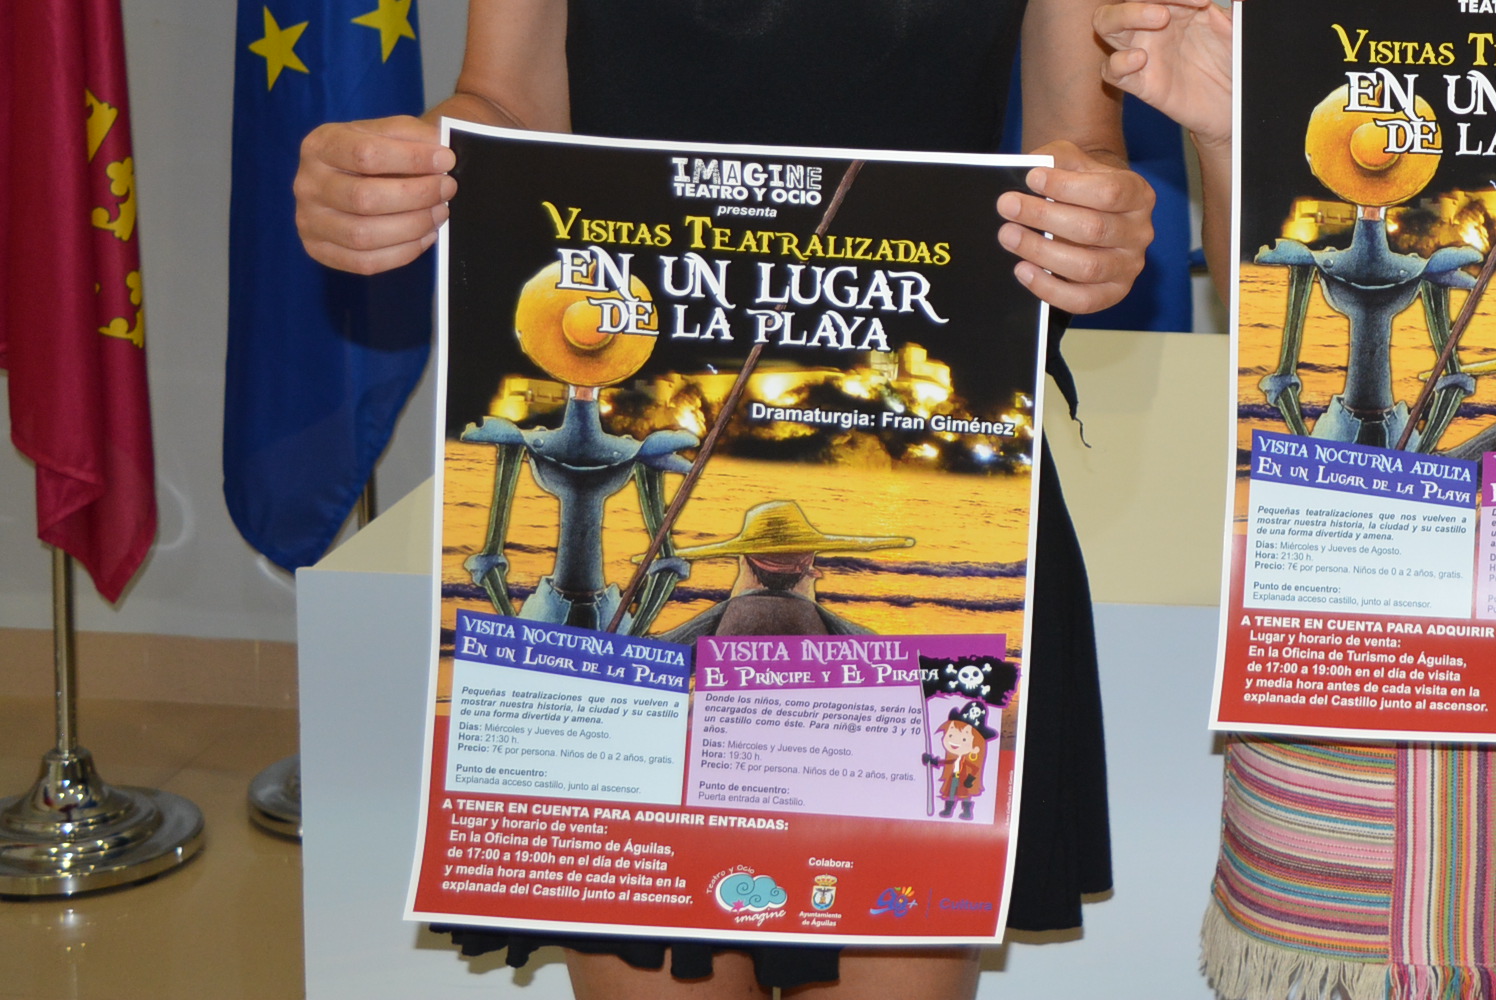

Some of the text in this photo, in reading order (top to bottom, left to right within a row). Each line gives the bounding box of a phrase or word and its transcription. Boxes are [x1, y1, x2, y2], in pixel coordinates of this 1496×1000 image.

[1331, 24, 1455, 66] VISITAS
[1344, 68, 1427, 121] EN
[1375, 118, 1443, 154] DE
[672, 157, 822, 190] IMAGINE
[673, 183, 822, 205] TEATRO Y OCIO
[717, 204, 778, 218] presenta
[542, 201, 950, 265] VISITAS TEATRALIZADAS
[556, 246, 949, 323] EN UN LUGAR
[588, 297, 891, 351] DE LA PLAYA
[752, 403, 1015, 436] Dramaturgia: Fran Giménez
[1258, 436, 1472, 482] VISITA NOCTURNA ADULTA
[1257, 456, 1471, 503] EN UN LUGAR DE LA PLAYA
[463, 616, 685, 666] VISITA NOCTURNA ADULTA
[1241, 616, 1251, 625] A
[1254, 616, 1300, 628] TENER
[1304, 618, 1323, 629] EN
[1327, 619, 1383, 633] CUENTA
[1386, 623, 1423, 634] PARA
[1426, 625, 1495, 638] ADQUIRIR
[462, 636, 684, 688] EN UN LUGAR DE LA PLAYA
[708, 639, 908, 665] VISITA INFANTIL
[705, 664, 939, 687] EL PRÍNCIPE Y EL PIRATA
[462, 687, 506, 699] Pequeñas
[512, 690, 582, 702] teatralizaciones
[588, 695, 605, 703] que
[633, 697, 668, 707] vuelven
[442, 799, 789, 830] A TENER EN CUENTA PARA ADQUIRIR ENTRADAS:
[451, 814, 608, 834] Lugar y horario de venta:
[449, 830, 675, 856] En la Oficina de Turismo de Águilas,
[808, 857, 854, 868] Colabora:
[799, 911, 842, 920] Ayuntamiento
[812, 918, 836, 928] Águilas
